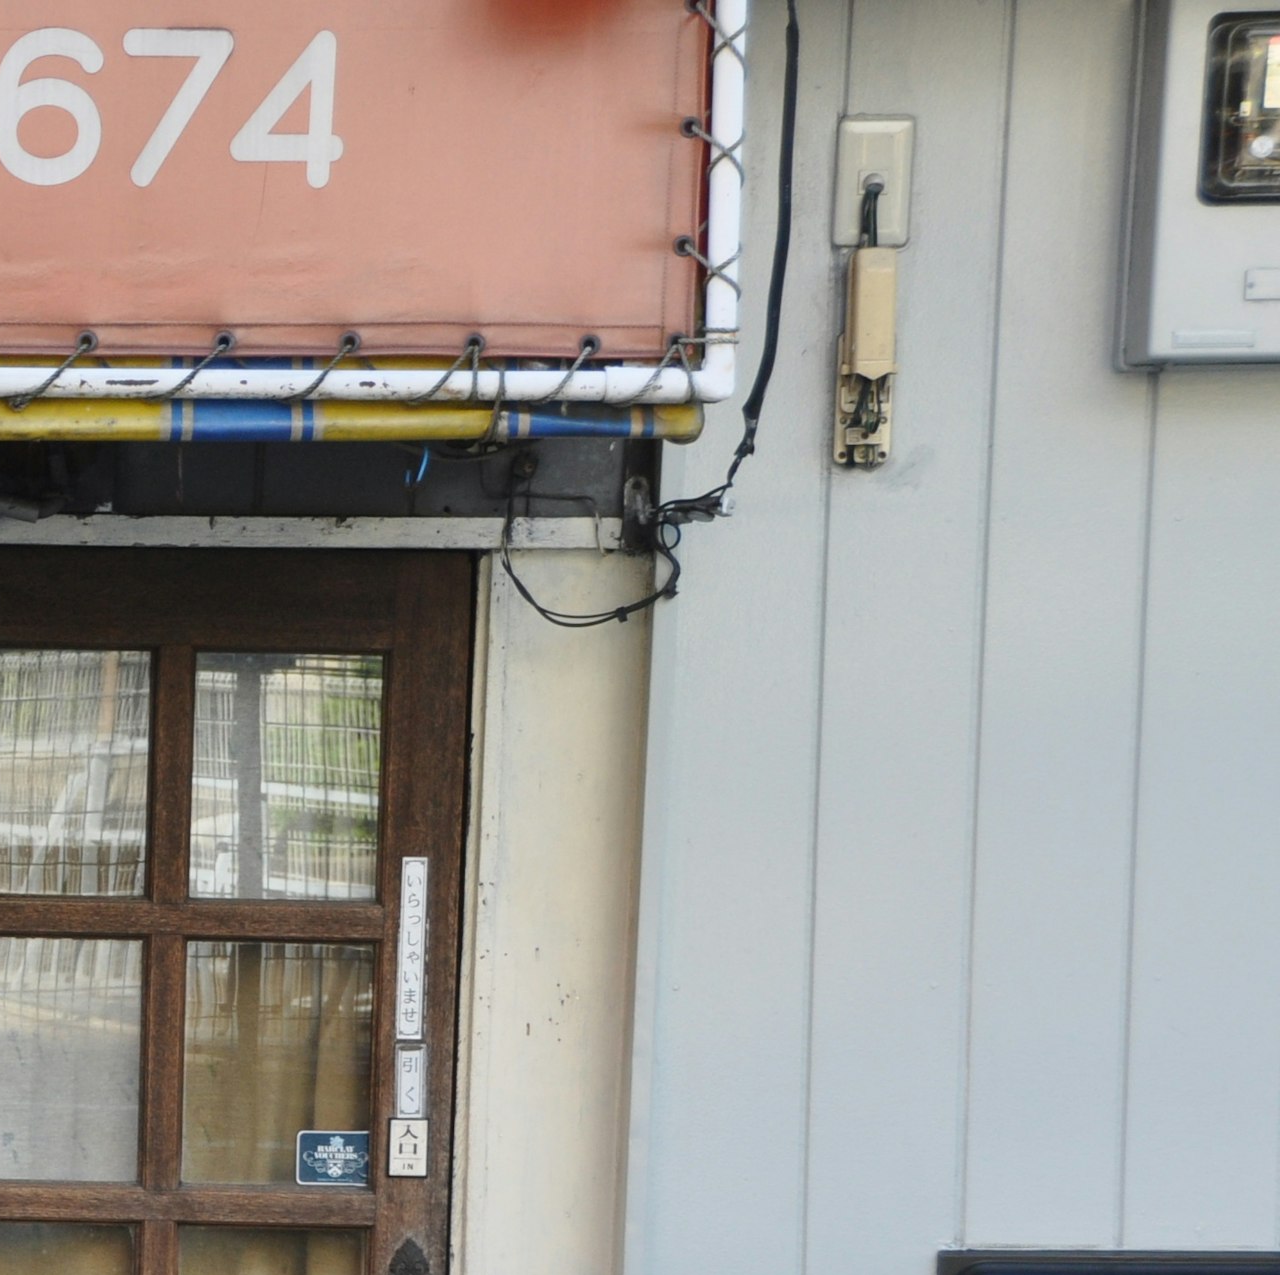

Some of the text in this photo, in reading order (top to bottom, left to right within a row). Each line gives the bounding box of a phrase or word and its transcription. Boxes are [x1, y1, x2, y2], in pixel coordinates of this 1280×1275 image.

[401, 874, 423, 1023] いらっしゃいませ
[402, 1056, 419, 1102] 引く
[398, 1124, 419, 1155] 入口
[402, 1163, 414, 1171] IN
